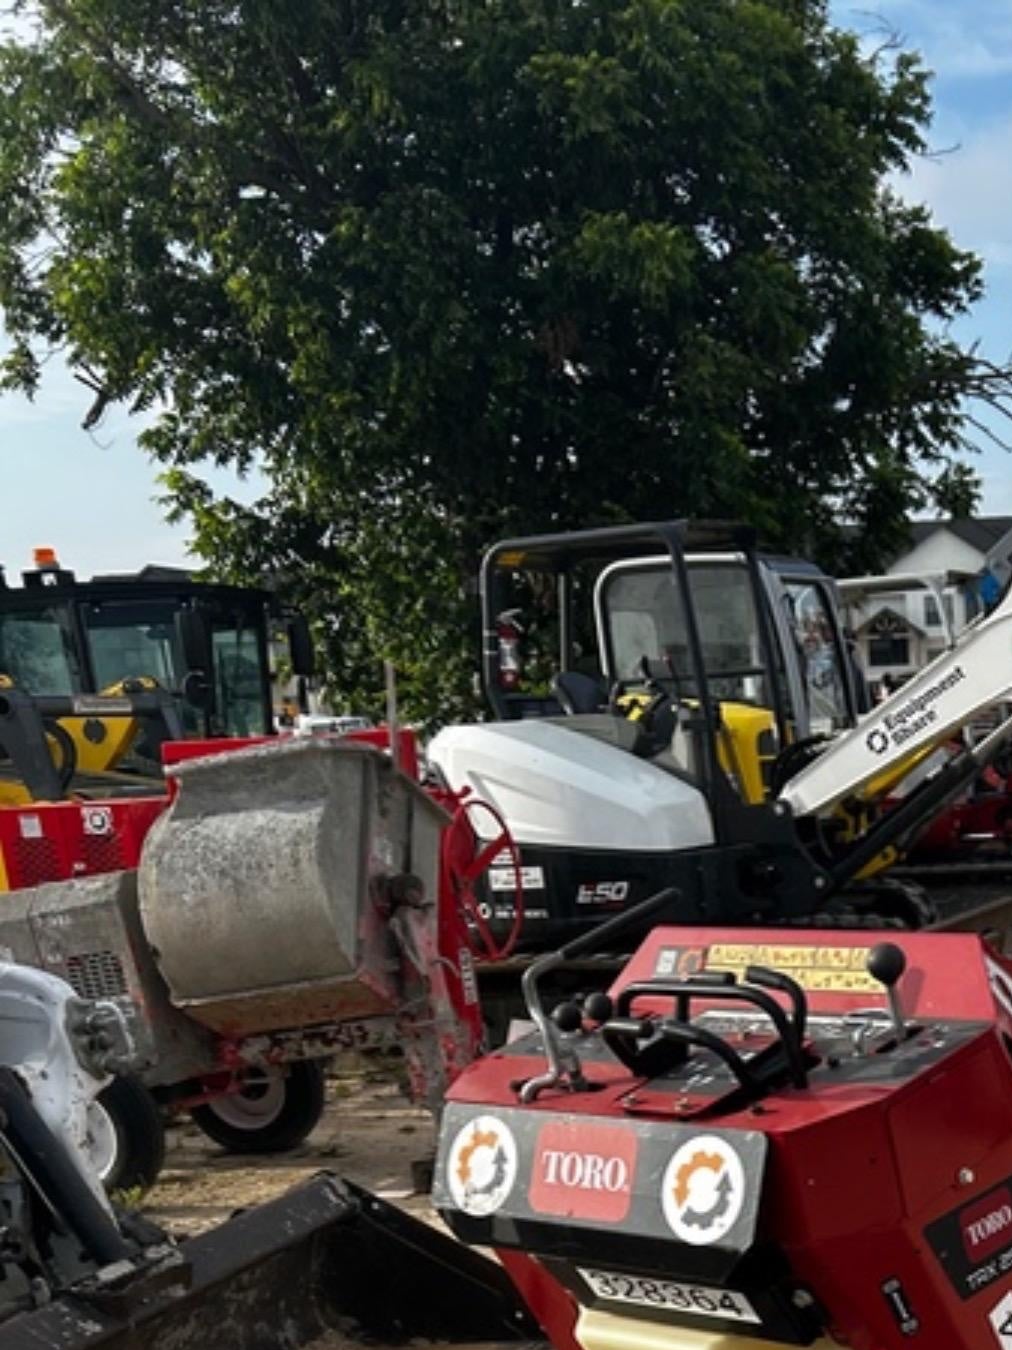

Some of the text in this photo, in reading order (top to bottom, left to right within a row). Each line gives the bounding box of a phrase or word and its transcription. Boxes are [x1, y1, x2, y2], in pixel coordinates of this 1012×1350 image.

[882, 665, 967, 732] Equipment
[890, 708, 938, 746] Share
[590, 1271, 744, 1316] 328364
